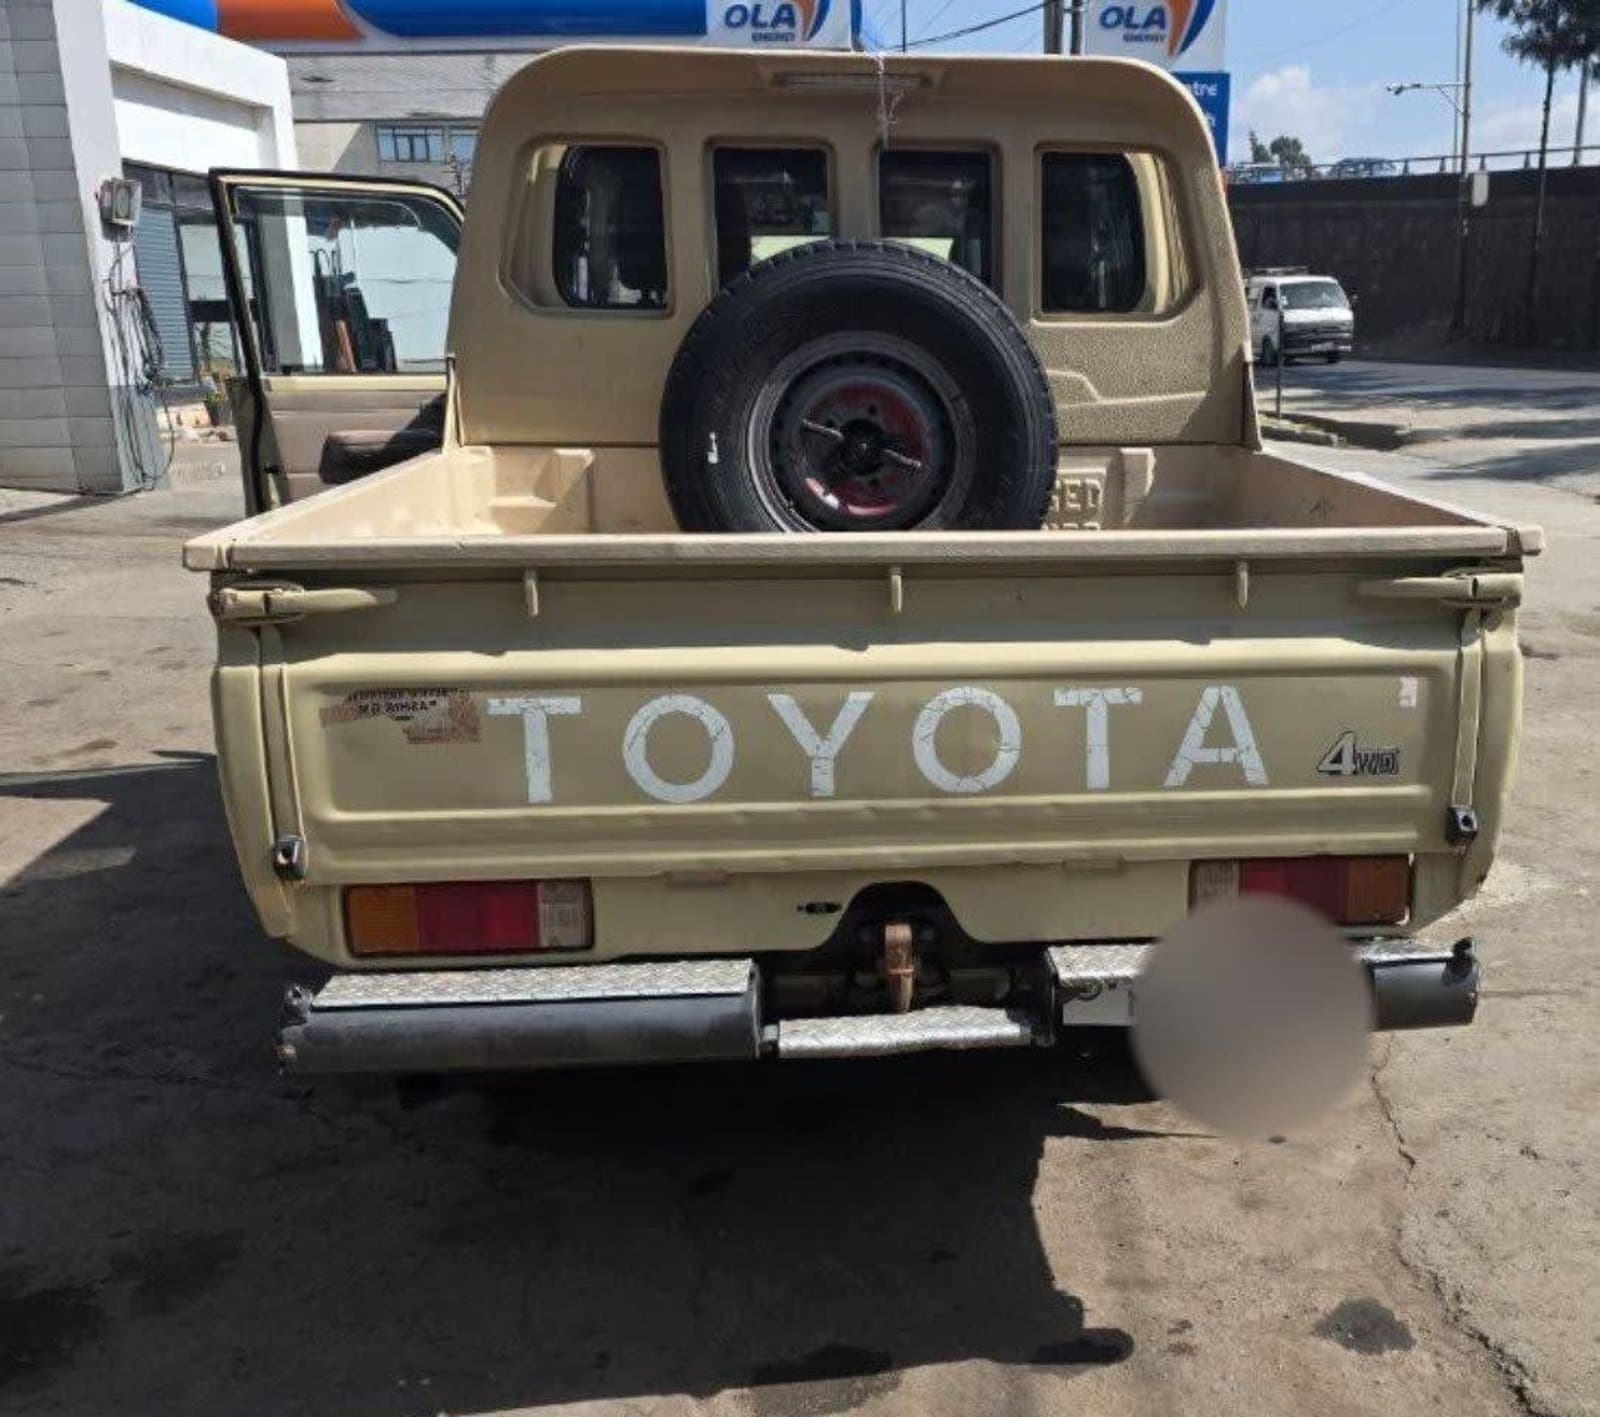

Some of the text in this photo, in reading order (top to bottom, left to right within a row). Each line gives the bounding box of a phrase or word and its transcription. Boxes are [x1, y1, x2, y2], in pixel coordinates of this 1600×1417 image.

[725, 3, 795, 28] OLA
[1100, 6, 1166, 30] OLA
[487, 685, 1269, 803] TOYOTA
[1316, 730, 1401, 776] 4WD
